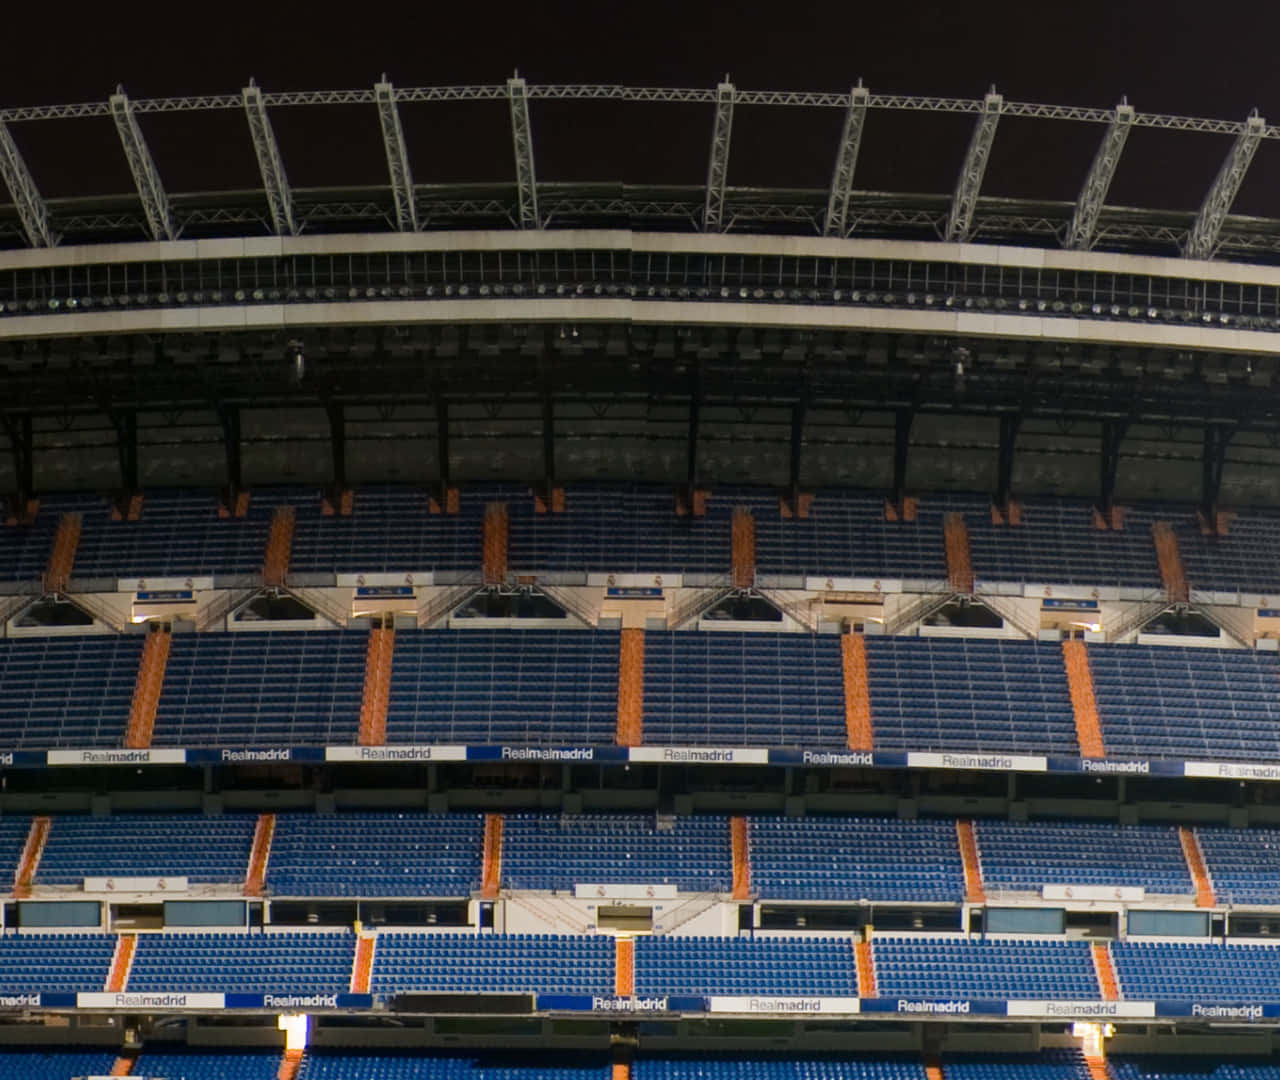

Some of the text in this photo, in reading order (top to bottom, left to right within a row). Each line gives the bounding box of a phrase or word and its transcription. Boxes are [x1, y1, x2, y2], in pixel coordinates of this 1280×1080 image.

[83, 752, 150, 763] Realmadrid
[222, 749, 290, 762] Realmadrid
[361, 748, 431, 759] Realmadrid
[663, 749, 733, 761] Realmadrid
[803, 751, 873, 765] Realmadrid
[1082, 760, 1150, 773] Realmadrid
[115, 995, 186, 1006] Realmadrid
[750, 999, 821, 1010] Realmadrid
[897, 1000, 970, 1013] Realmadrid
[1047, 1003, 1117, 1014] Realmadrid
[1192, 1004, 1263, 1017] Realmadrid
